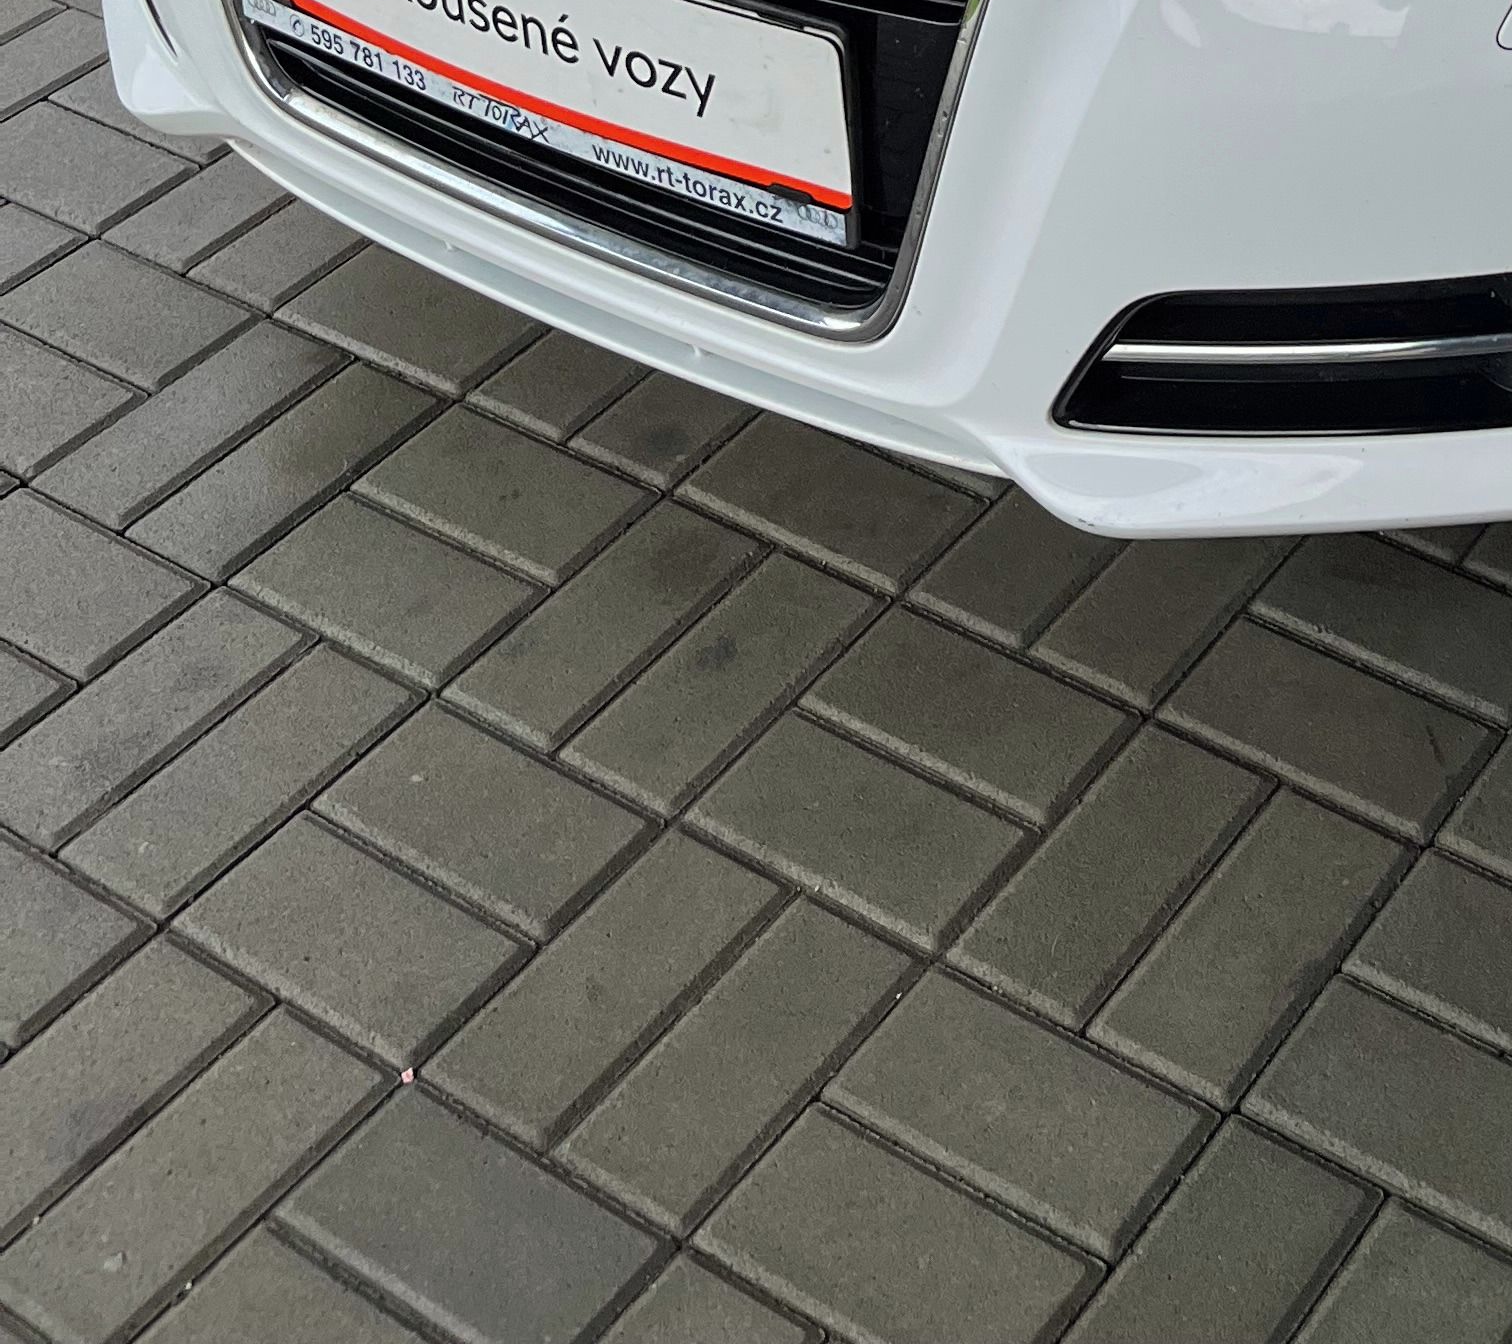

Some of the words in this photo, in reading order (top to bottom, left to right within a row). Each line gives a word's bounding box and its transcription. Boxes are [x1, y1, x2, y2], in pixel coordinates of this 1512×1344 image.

[310, 22, 345, 56] 595
[350, 40, 383, 73] 781
[392, 59, 427, 92] 133
[592, 36, 716, 118] vozy
[592, 143, 784, 224] www.rt-torax.cz
